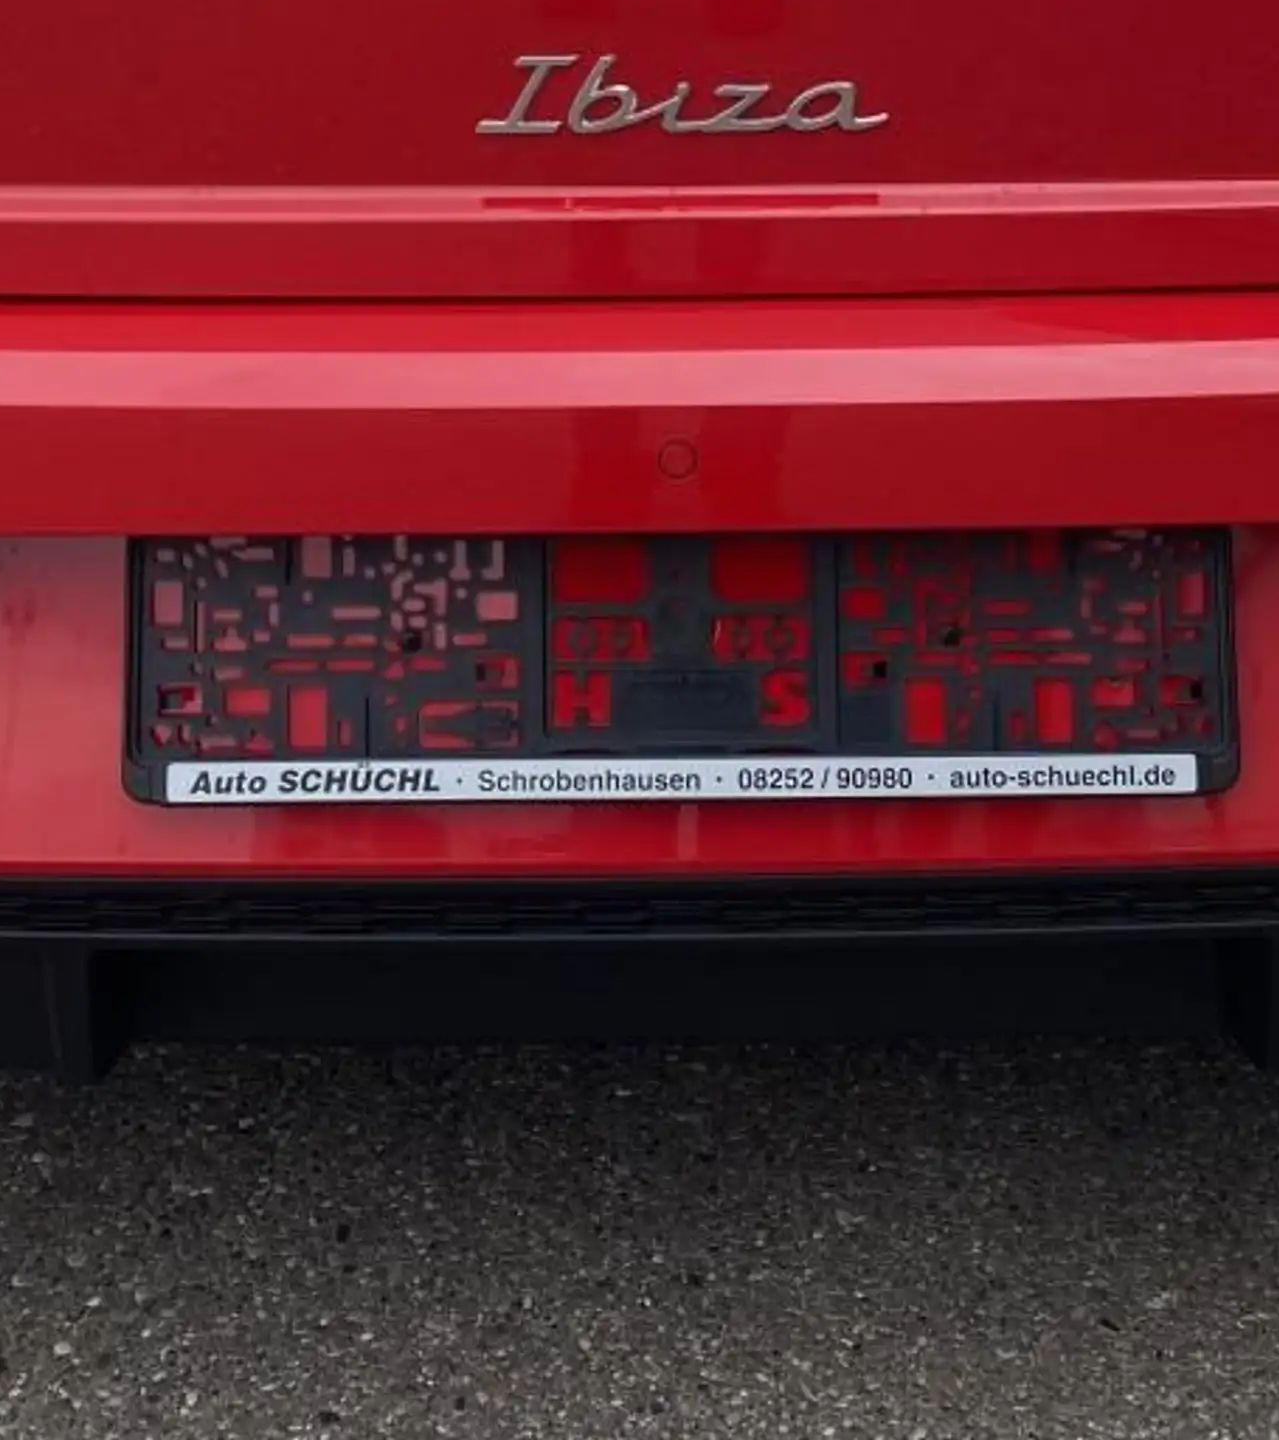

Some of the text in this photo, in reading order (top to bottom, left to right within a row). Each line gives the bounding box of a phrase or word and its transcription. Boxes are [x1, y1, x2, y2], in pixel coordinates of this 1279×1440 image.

[475, 53, 889, 135] Ibiza
[190, 770, 267, 794] Auto
[277, 762, 441, 793] SCHÜCHL
[477, 769, 702, 792] Schrobenhausen
[949, 765, 1177, 788] auto-schuechl.de
